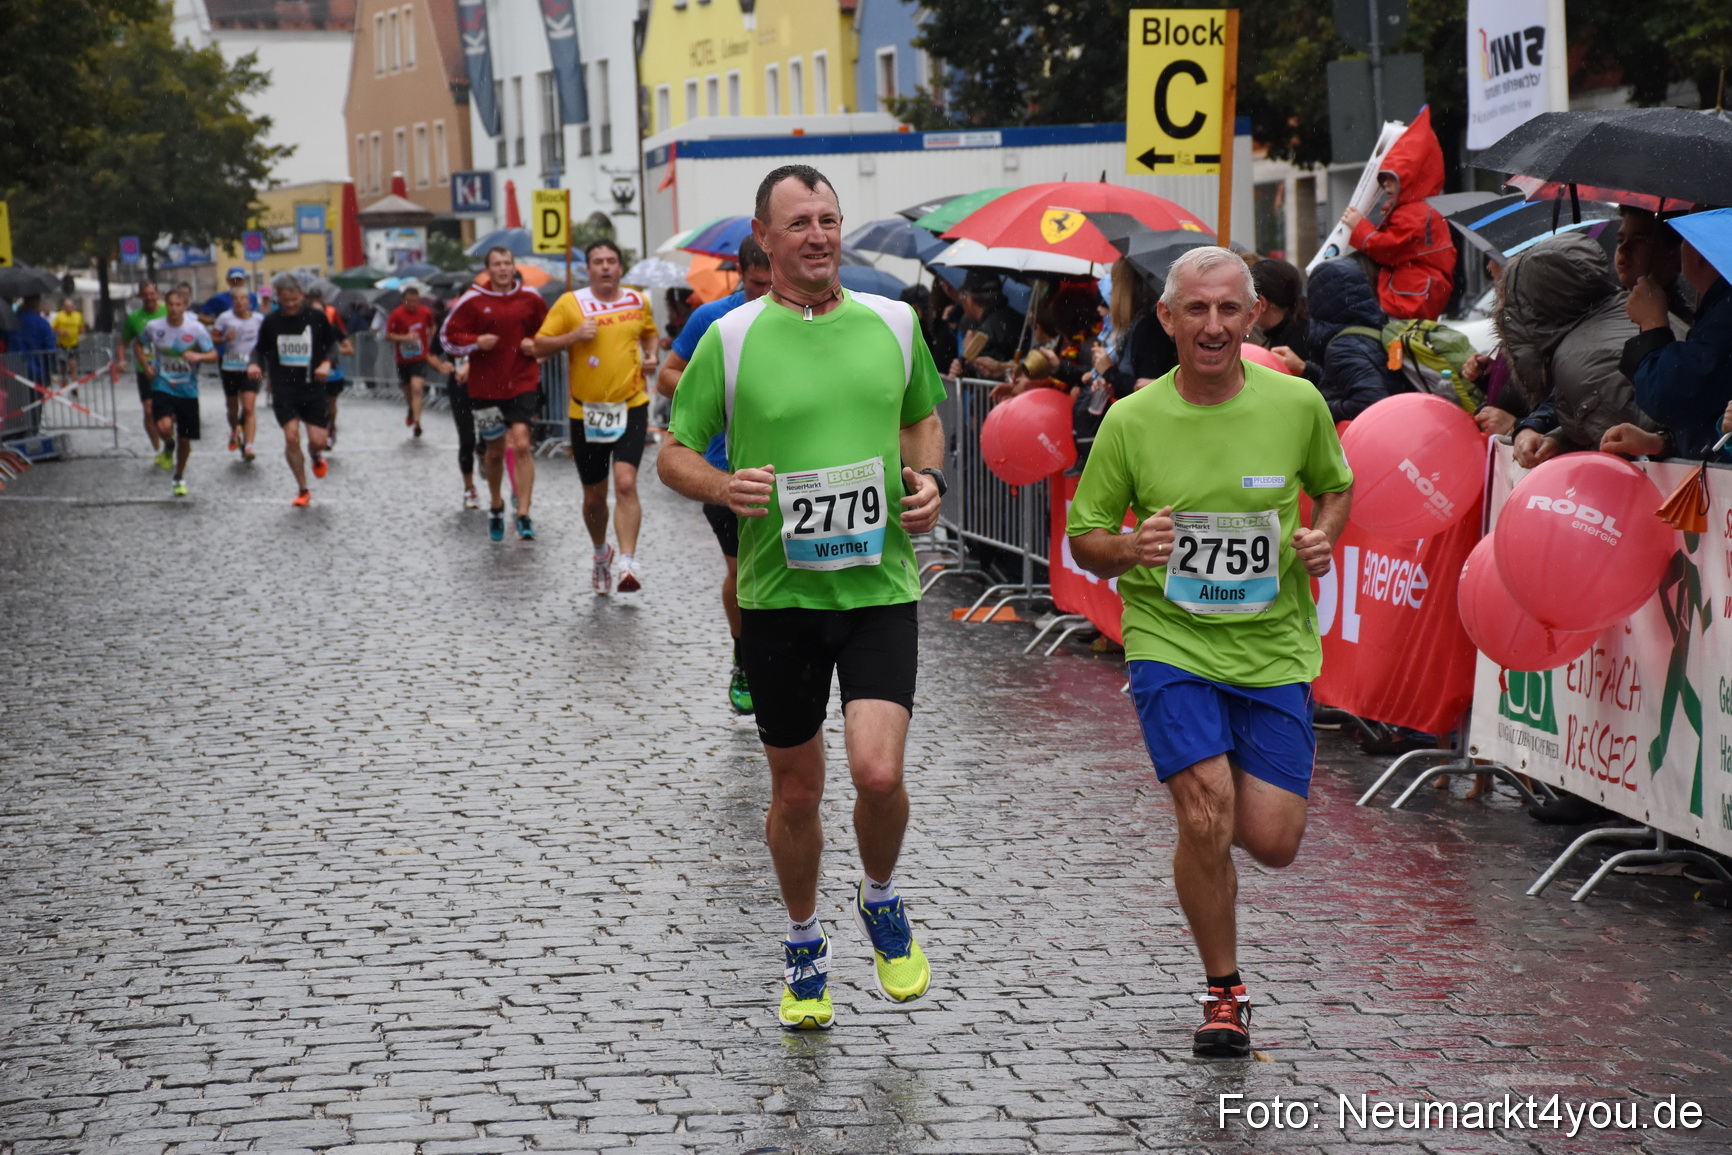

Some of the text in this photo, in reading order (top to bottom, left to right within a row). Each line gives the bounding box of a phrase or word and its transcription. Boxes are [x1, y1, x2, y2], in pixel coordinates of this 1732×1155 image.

[1142, 17, 1225, 46] Block
[1154, 59, 1208, 140] C
[542, 208, 561, 239] D
[786, 482, 821, 491] NeuerMarkt
[827, 463, 876, 484] BOCK
[792, 486, 880, 534] 2779
[1217, 516, 1271, 529] BOCK
[1526, 487, 1623, 538] RÖDL
[1571, 519, 1618, 546] energie
[815, 541, 869, 557] Werner
[1178, 536, 1270, 575] 2759
[1199, 584, 1246, 601] Alfons
[1565, 714, 1638, 792] BESSER
